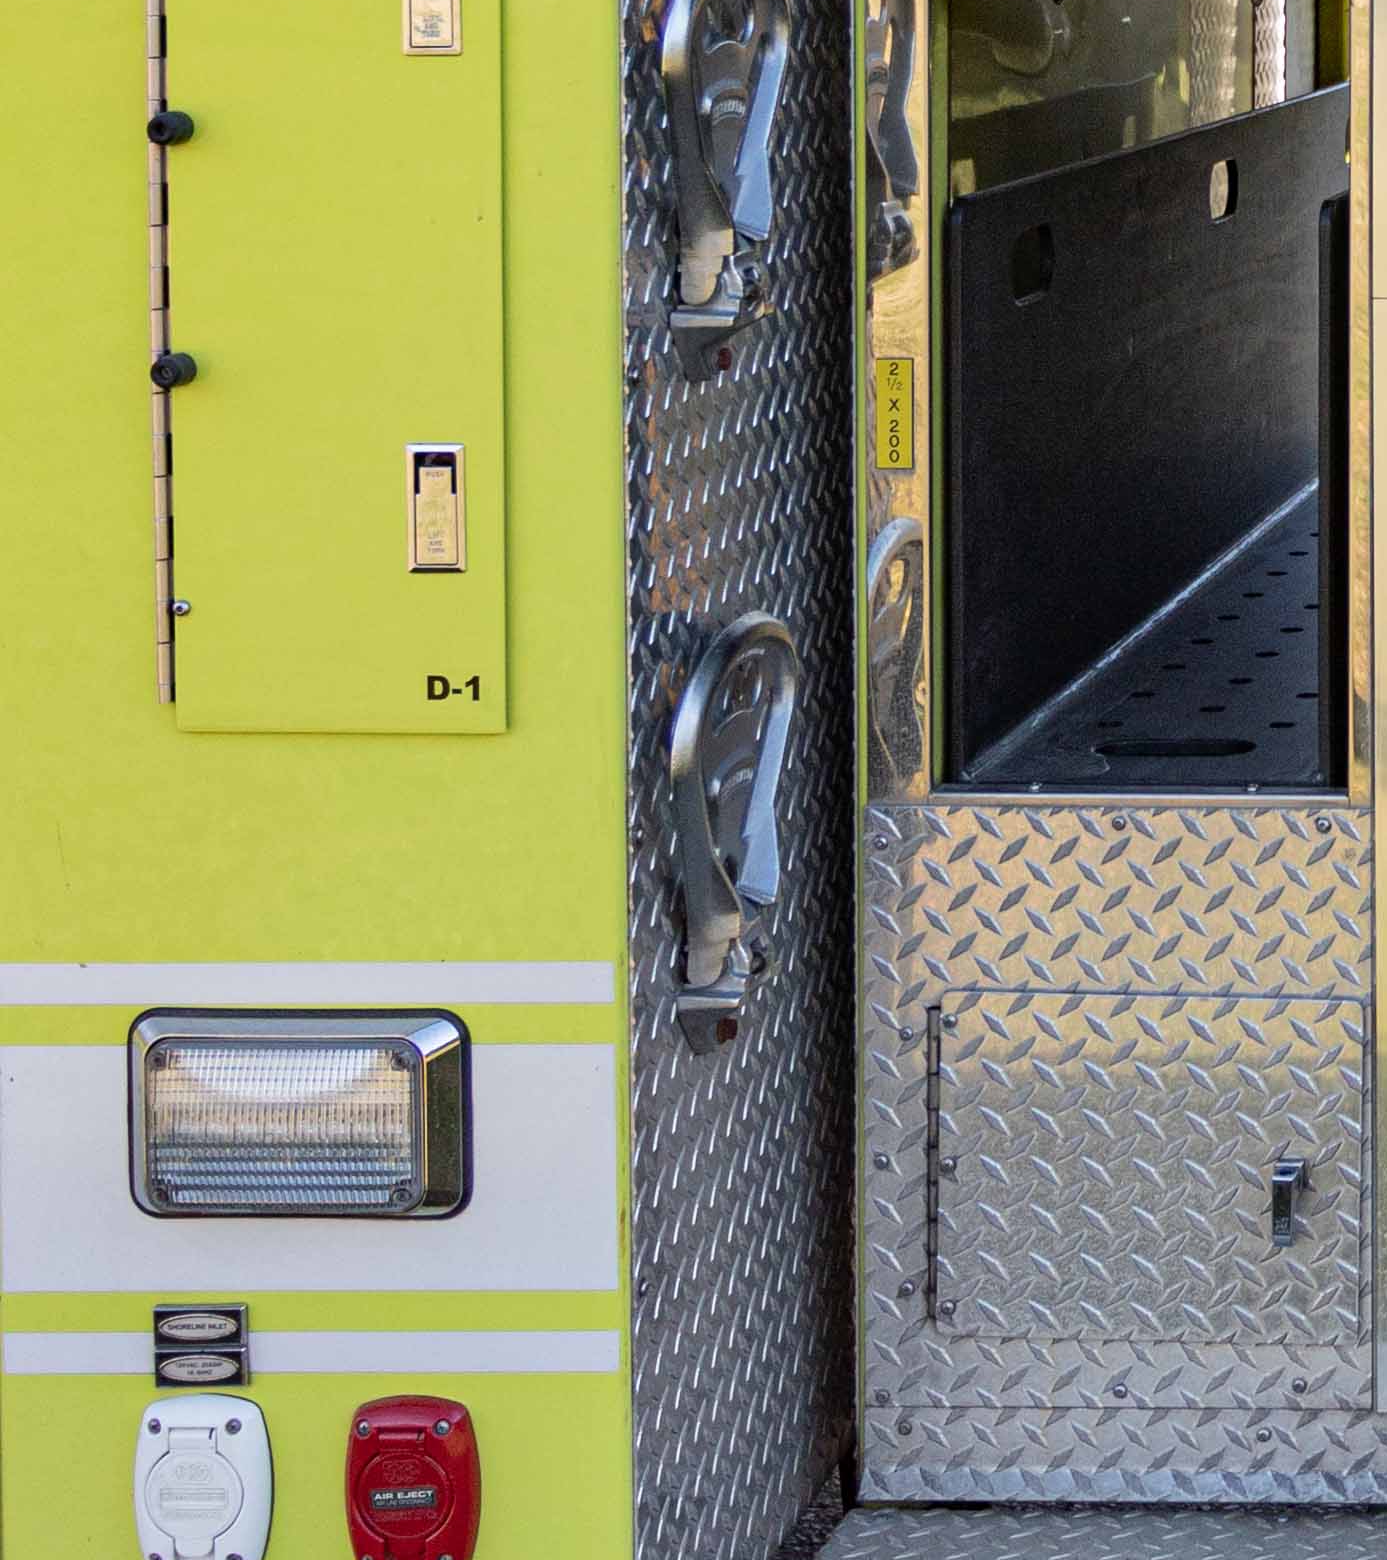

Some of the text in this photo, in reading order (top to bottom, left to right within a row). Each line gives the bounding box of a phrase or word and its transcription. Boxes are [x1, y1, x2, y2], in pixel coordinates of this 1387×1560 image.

[889, 362, 898, 376] 2
[888, 399, 900, 412] X
[427, 675, 481, 701] D-1
[167, 1322, 228, 1331] SHORELINE INLET
[374, 1490, 434, 1501] AIR EJECT
